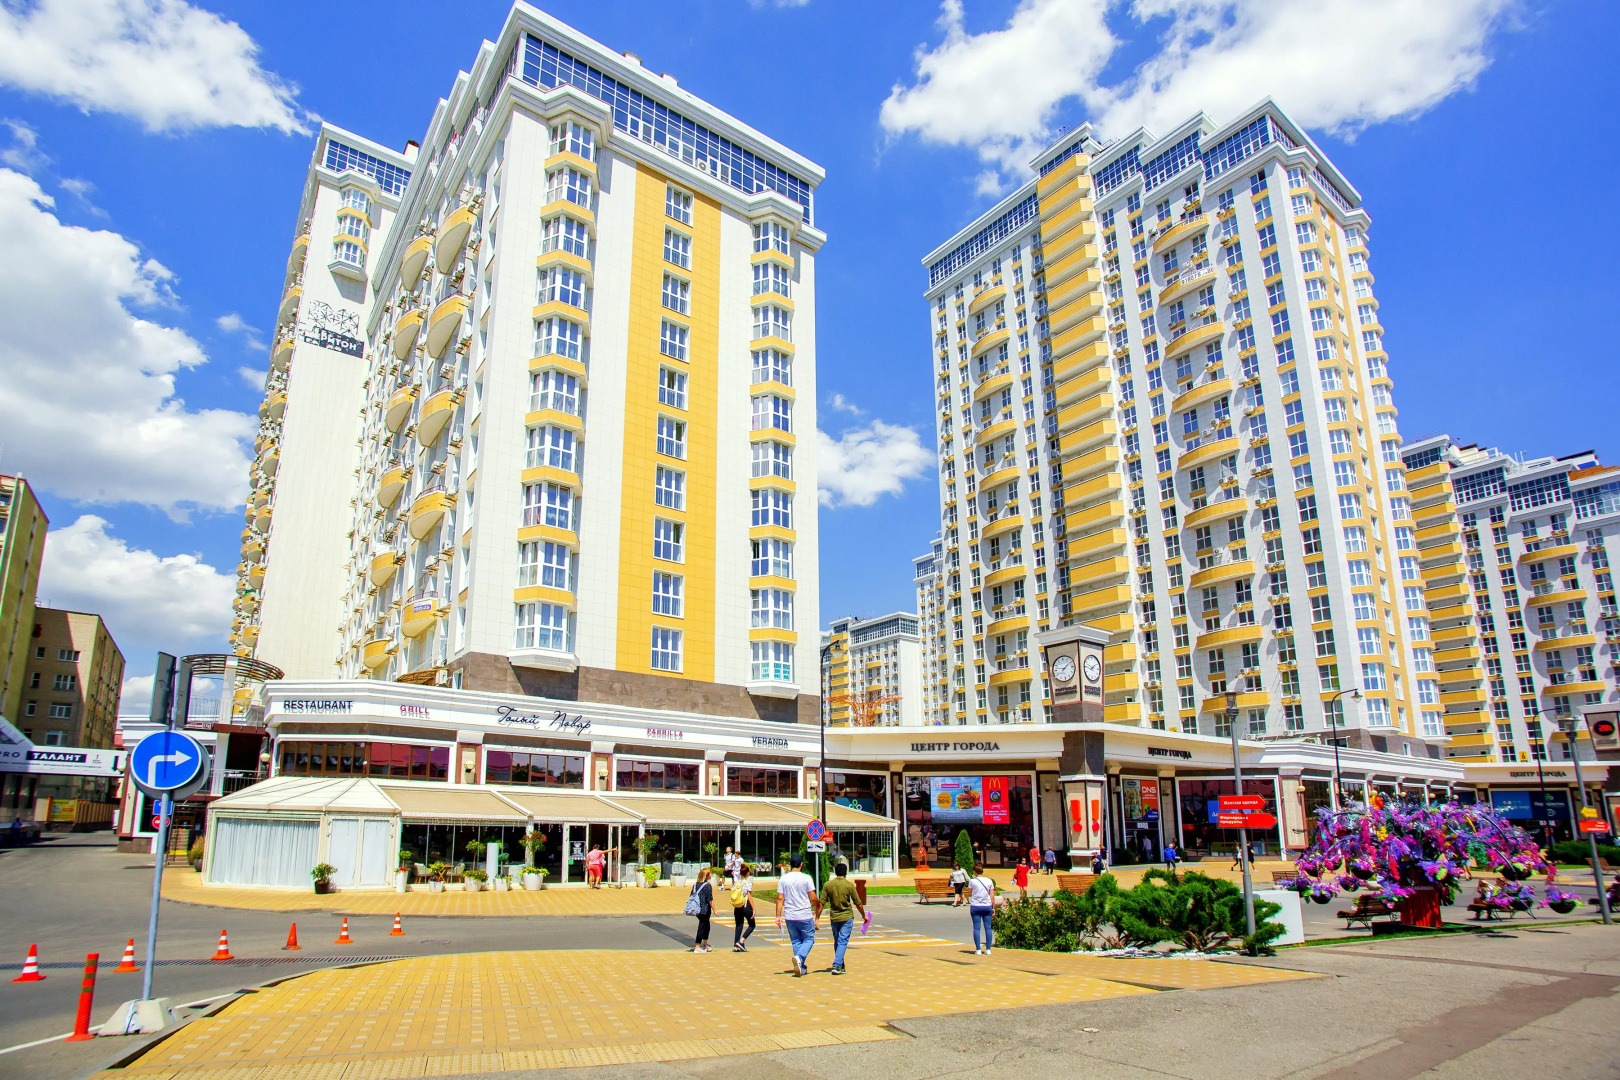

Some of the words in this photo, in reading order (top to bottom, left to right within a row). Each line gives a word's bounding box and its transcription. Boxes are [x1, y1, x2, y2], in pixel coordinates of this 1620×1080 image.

[283, 700, 353, 710] RESTAURANT
[400, 704, 430, 714] GRILL
[496, 705, 540, 725] Голый
[549, 710, 591, 736] Повар
[646, 727, 683, 737] PARRILLA
[752, 736, 789, 746] VERANDA
[911, 742, 950, 752] ЦЕНТР
[953, 742, 1000, 752] ГОРОДА
[32, 752, 81, 762] ТАЛАНТ
[1148, 747, 1168, 756] ЦЕНТР
[1169, 749, 1192, 759] ГОРОДА
